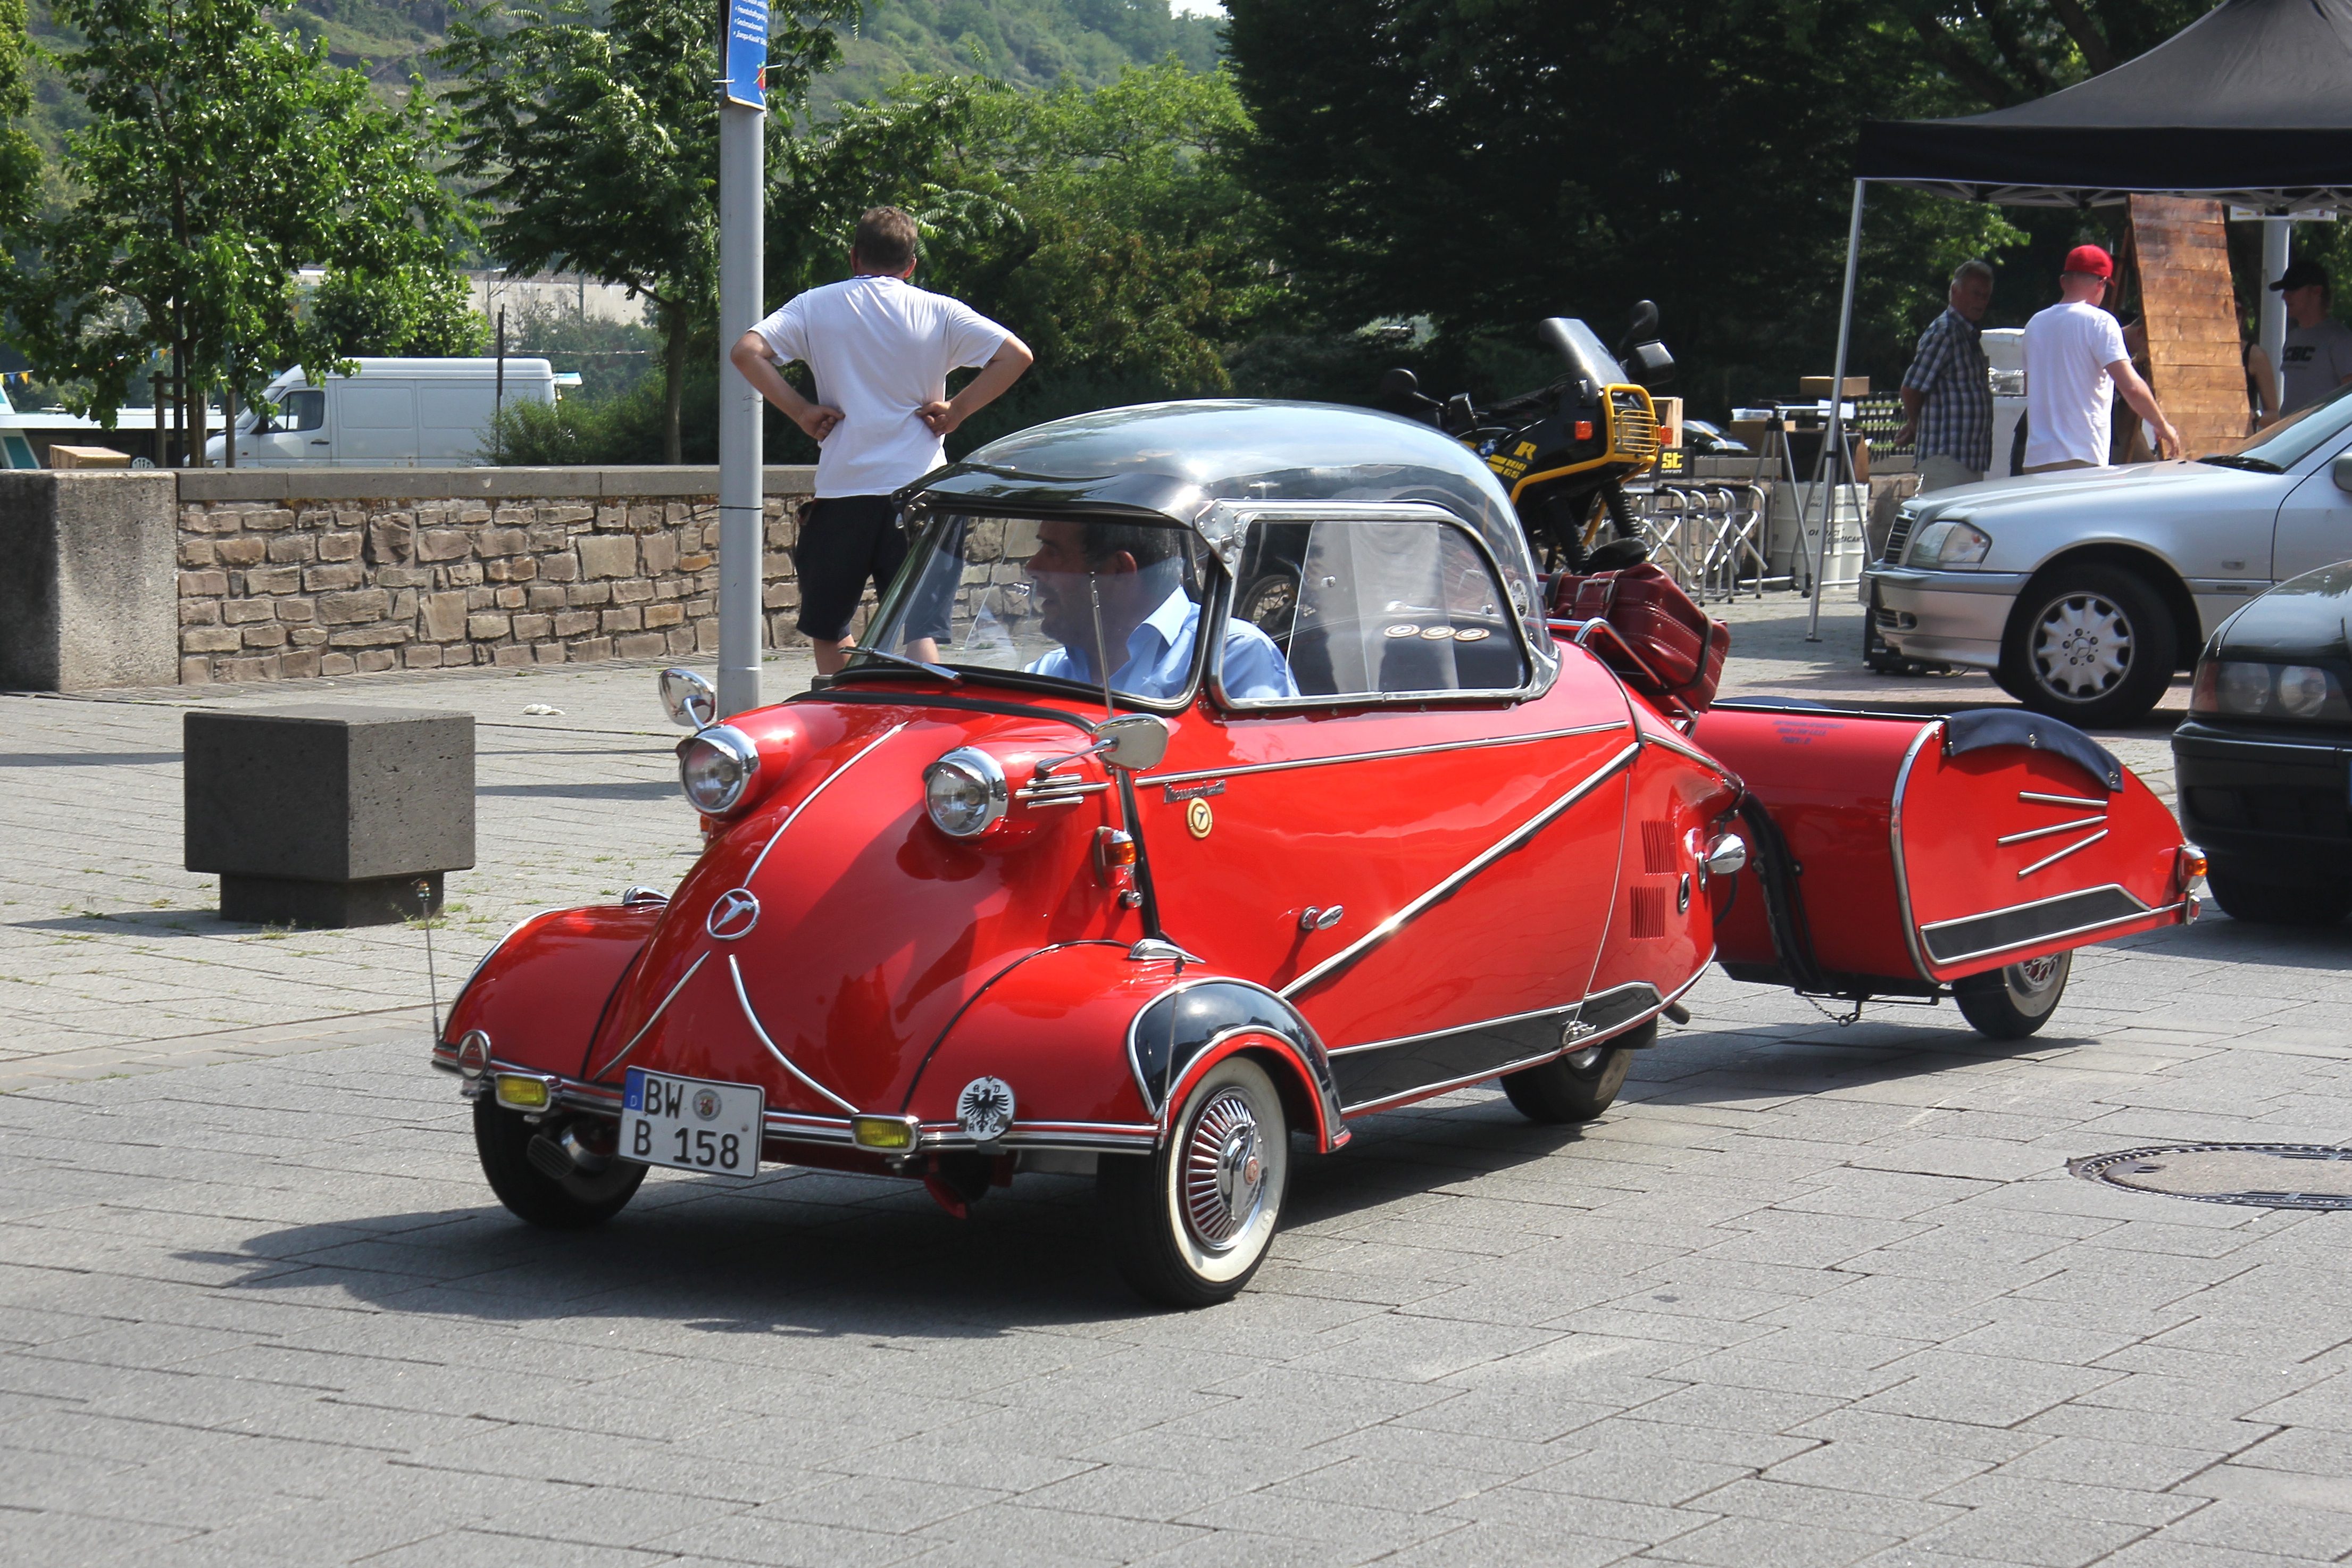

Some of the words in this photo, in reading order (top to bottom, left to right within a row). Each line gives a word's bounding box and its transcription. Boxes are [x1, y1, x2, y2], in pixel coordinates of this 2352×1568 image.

[1513, 441, 1537, 461] R
[630, 1095, 638, 1107] D
[645, 1078, 683, 1119] BW
[633, 1119, 652, 1156] B
[673, 1127, 739, 1169] 158
